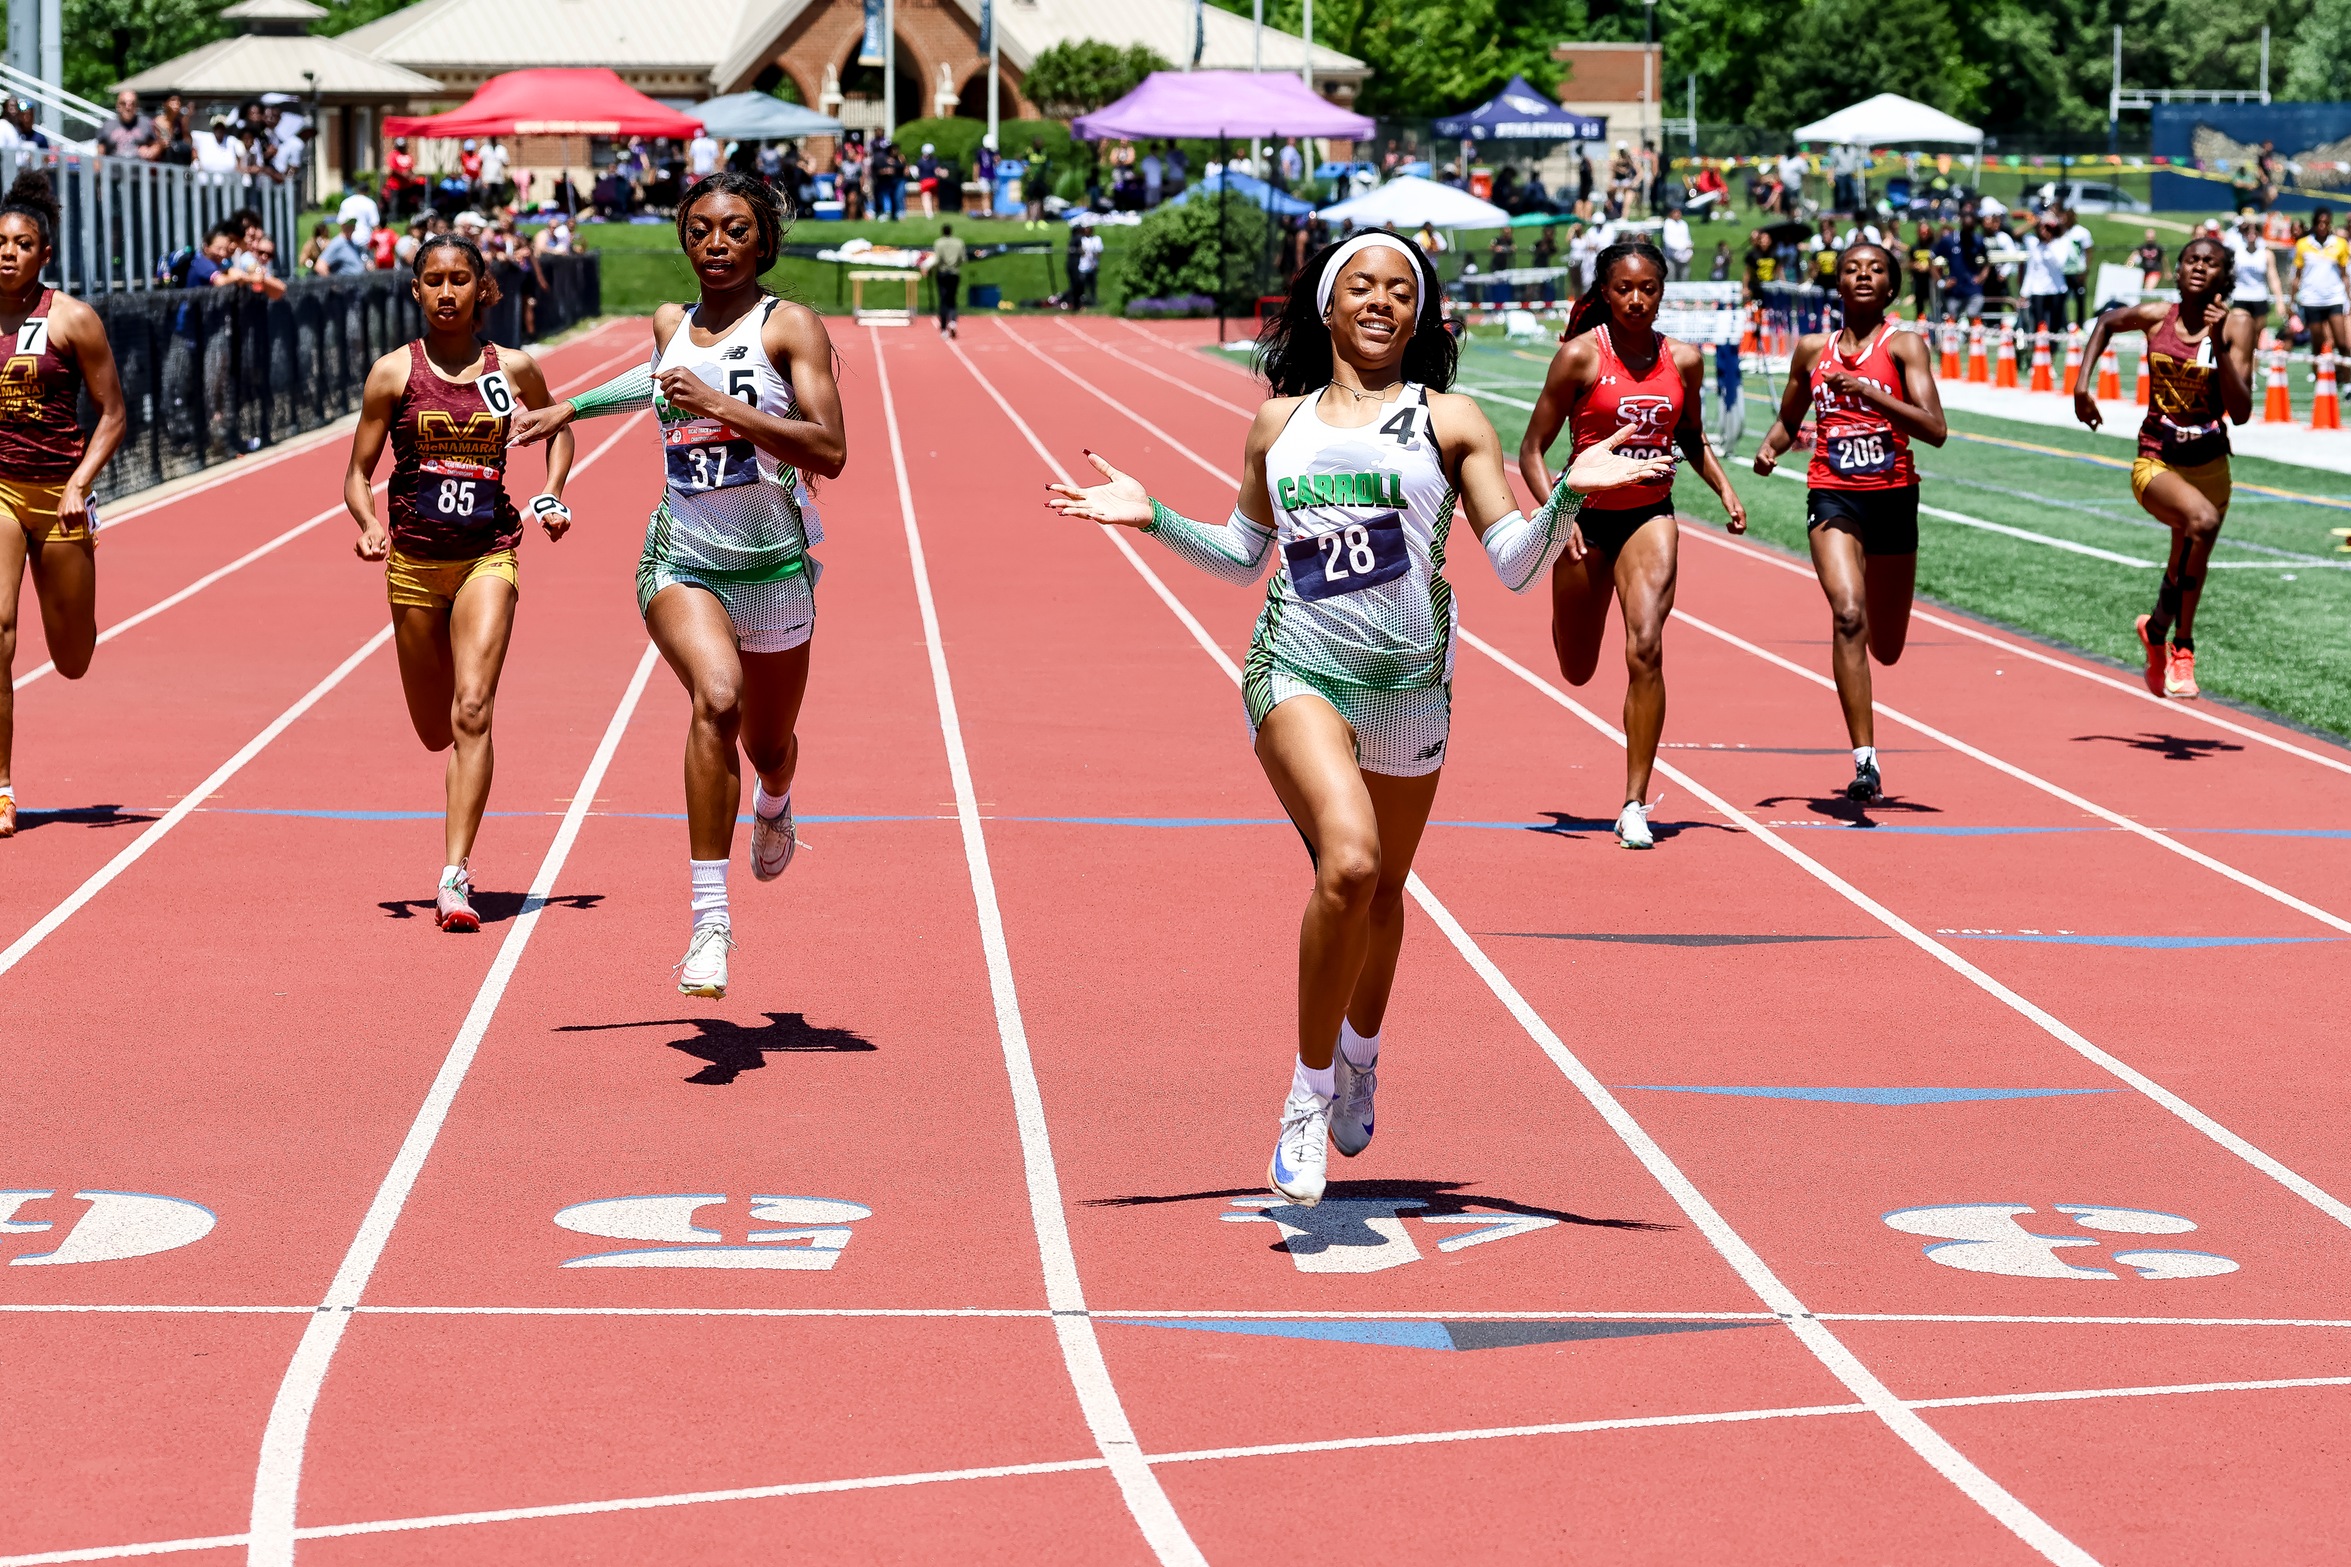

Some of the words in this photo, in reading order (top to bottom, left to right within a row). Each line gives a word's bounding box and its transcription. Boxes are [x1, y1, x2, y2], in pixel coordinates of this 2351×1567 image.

[23, 322, 42, 350] 7
[483, 376, 510, 412] 6
[729, 370, 757, 409] 5
[1379, 407, 1417, 444] 4
[418, 442, 497, 453] McNAMARA
[1837, 435, 1885, 469] 206
[688, 446, 728, 489] 37
[437, 479, 476, 516] 85
[1277, 472, 1408, 513] CARROLL
[1318, 524, 1375, 582] 28
[552, 1192, 874, 1272] 5
[1219, 1196, 1560, 1274] 4
[1881, 1202, 2242, 1281] 3
